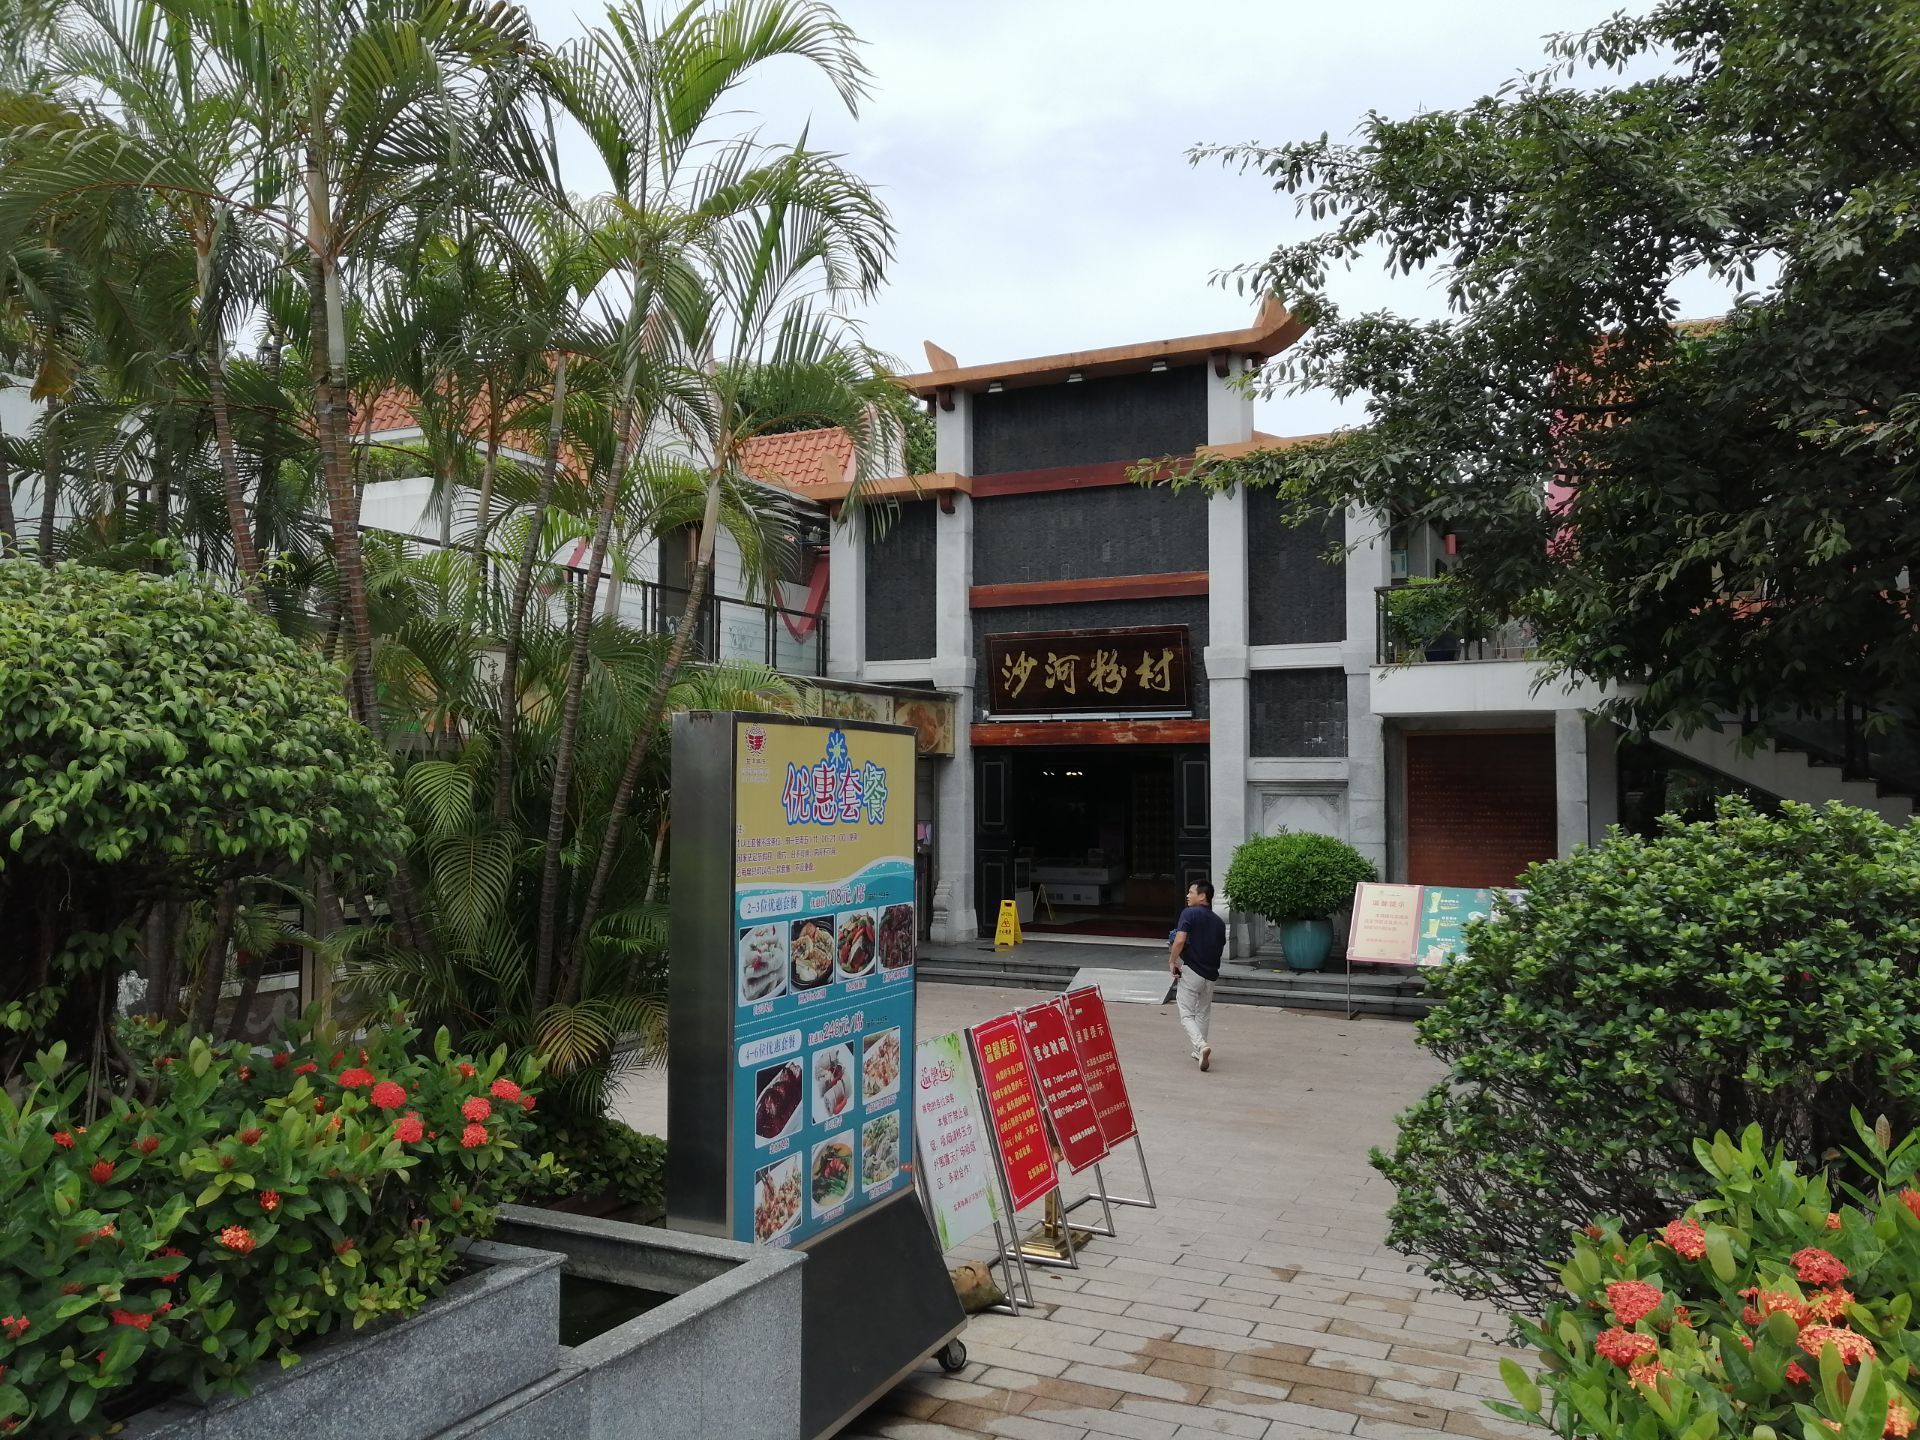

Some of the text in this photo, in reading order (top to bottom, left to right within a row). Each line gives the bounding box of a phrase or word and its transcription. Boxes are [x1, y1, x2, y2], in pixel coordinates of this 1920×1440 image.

[1001, 648, 1175, 698] 沙河粉村
[784, 760, 887, 824] 优惠套餐
[984, 1035, 1018, 1064] 温馨提示
[1033, 1037, 1069, 1062] 营业时间
